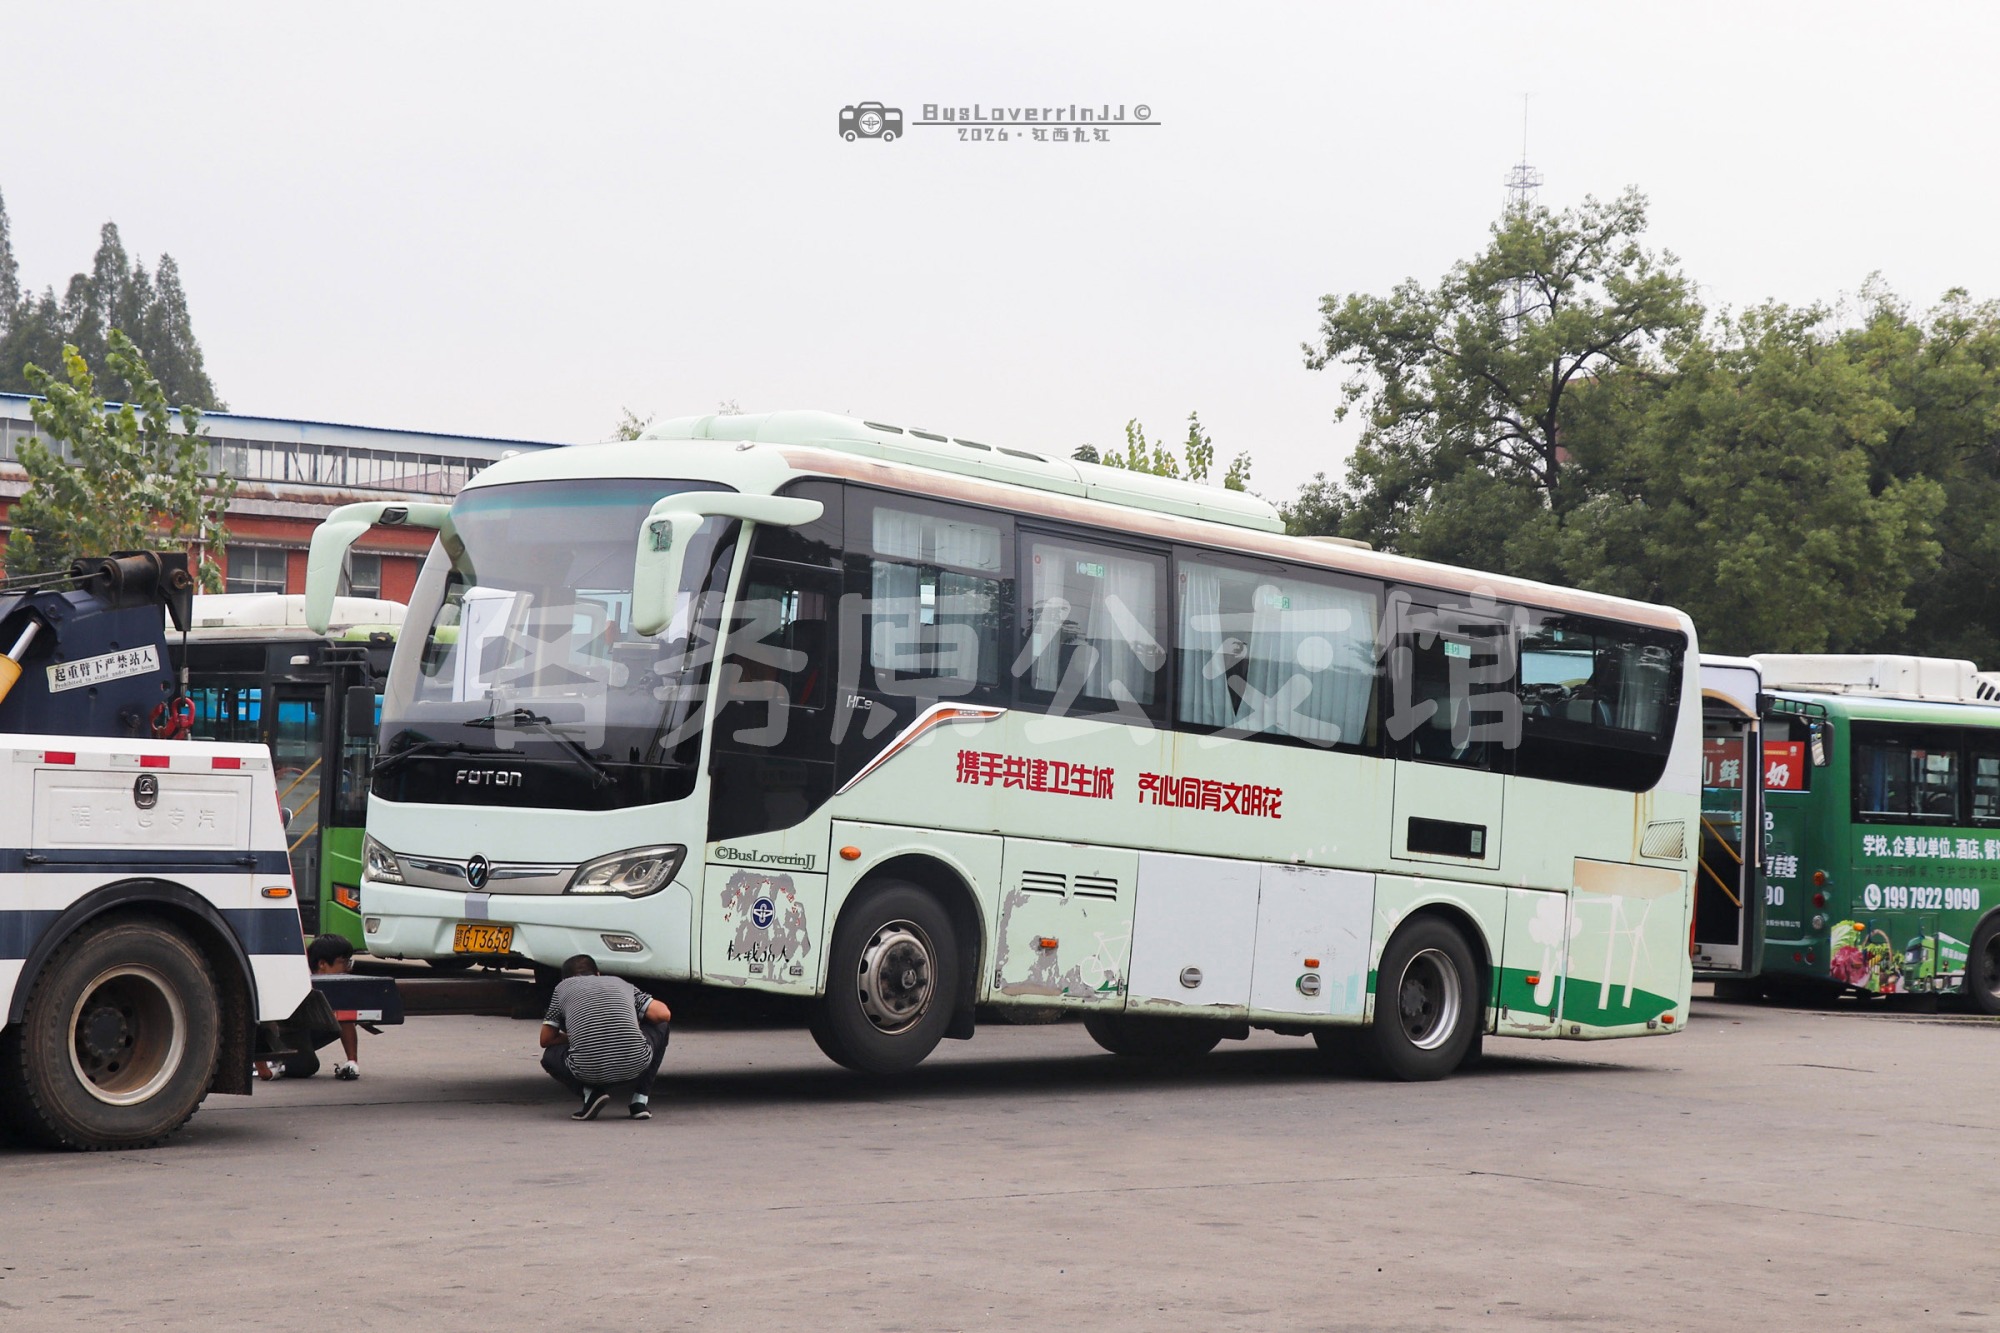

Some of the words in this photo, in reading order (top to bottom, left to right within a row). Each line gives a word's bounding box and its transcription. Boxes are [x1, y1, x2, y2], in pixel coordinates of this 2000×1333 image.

[55, 650, 152, 682] 起重臂下严禁站人
[455, 770, 522, 787] FOTON
[956, 749, 1114, 800] 携手共建卫生城
[1137, 771, 1284, 819] 齐心同育文明花
[1883, 886, 1908, 909] 199
[1910, 886, 1942, 909] 7922
[1944, 887, 1980, 910] 9090
